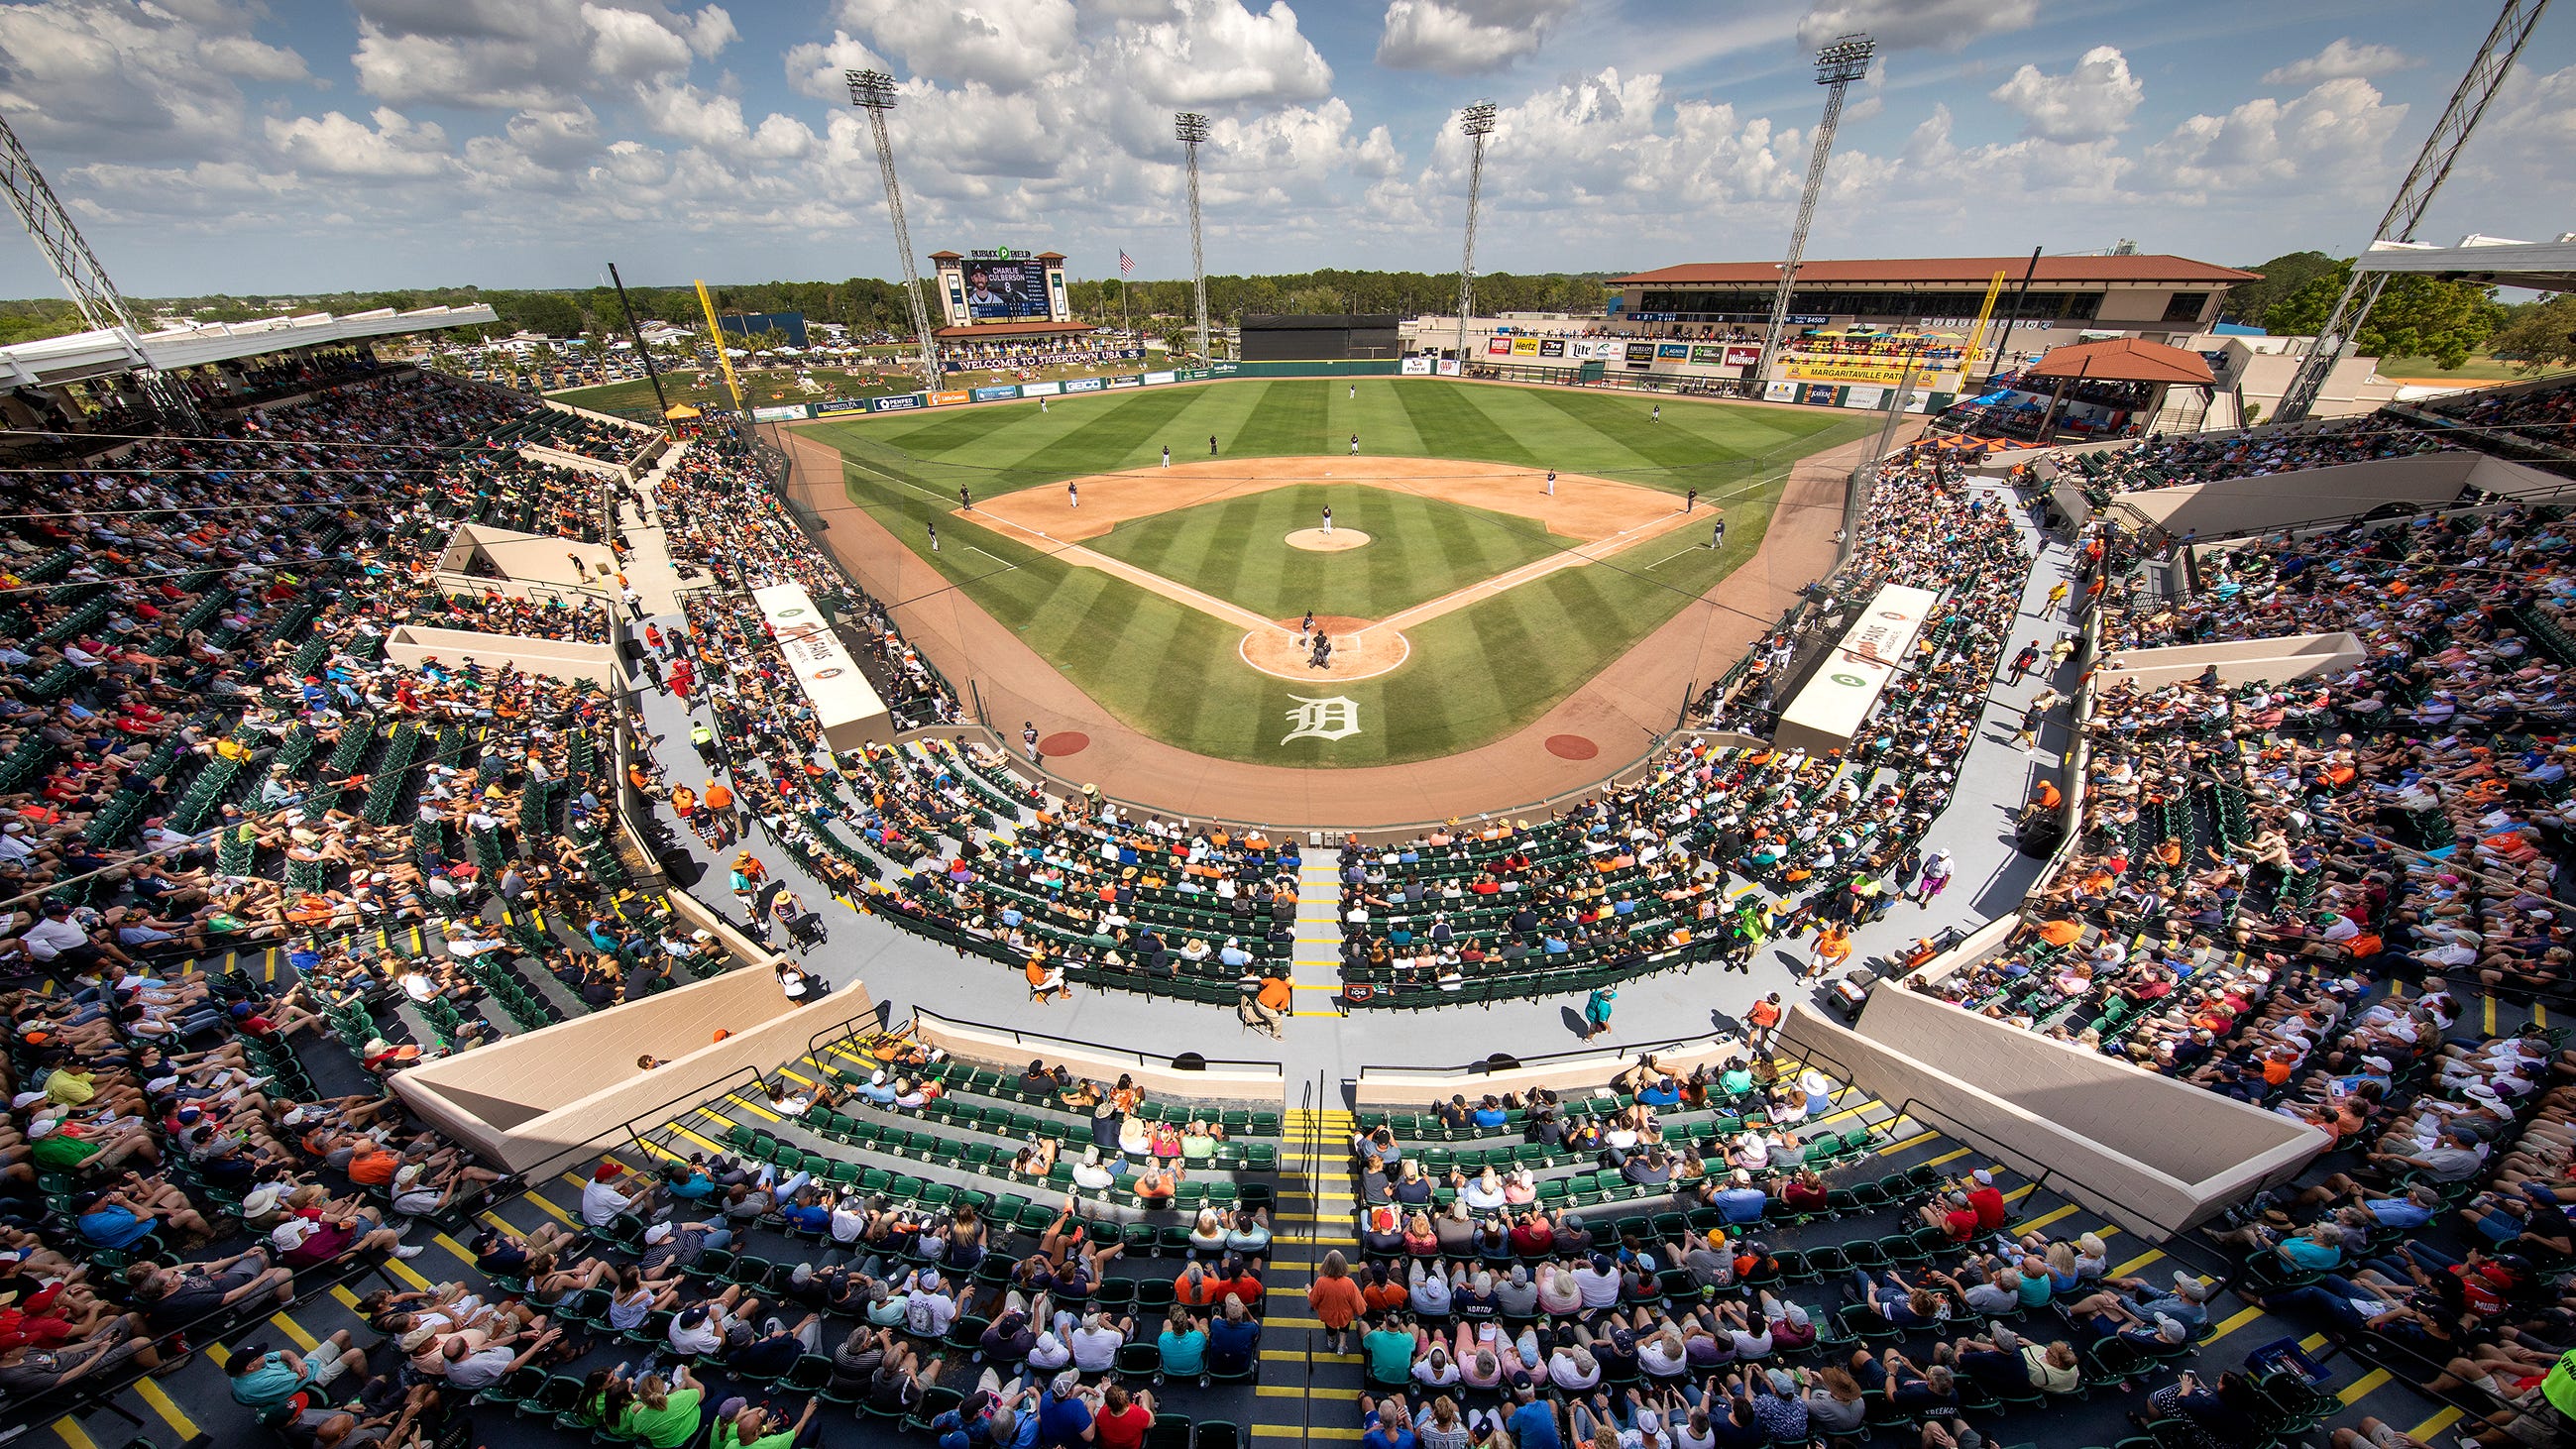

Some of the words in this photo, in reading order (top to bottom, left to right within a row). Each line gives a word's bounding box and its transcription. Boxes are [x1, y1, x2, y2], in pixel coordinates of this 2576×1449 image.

[1004, 281, 1011, 292] 8
[1515, 342, 1537, 351] Hertz
[1573, 343, 1591, 358] Lite
[958, 358, 1018, 371] WELCOME
[1021, 356, 1036, 366] TO
[1039, 352, 1099, 365] TIGERTOWN
[1102, 350, 1122, 360] USA
[1728, 353, 1757, 365] Wawa
[1811, 369, 1882, 379] MARGARITAVILLE
[1067, 381, 1100, 390] GEICO
[1861, 624, 1889, 643] FANS
[807, 642, 834, 661] FANS
[1280, 693, 1363, 746] D
